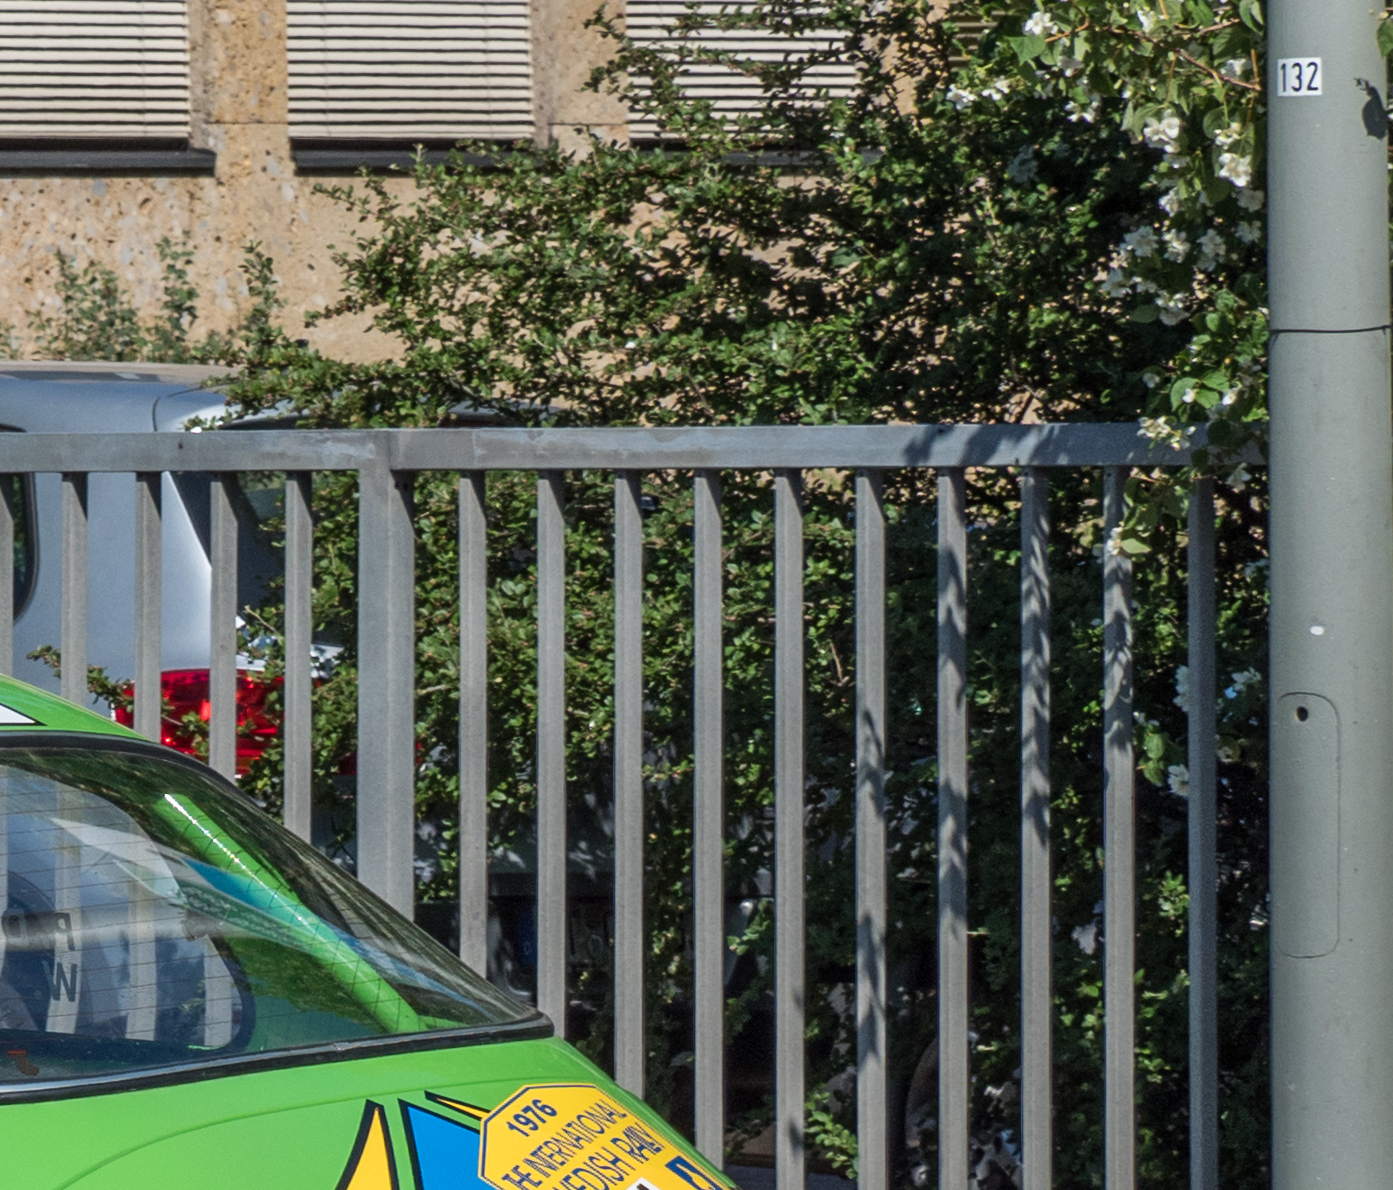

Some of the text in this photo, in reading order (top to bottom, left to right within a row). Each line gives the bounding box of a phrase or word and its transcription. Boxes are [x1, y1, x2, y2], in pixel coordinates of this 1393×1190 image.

[1280, 62, 1319, 93] 132
[506, 1099, 558, 1137] 1976
[522, 1099, 627, 1178] INTERNATIONAL
[611, 1121, 665, 1164] RALLY
